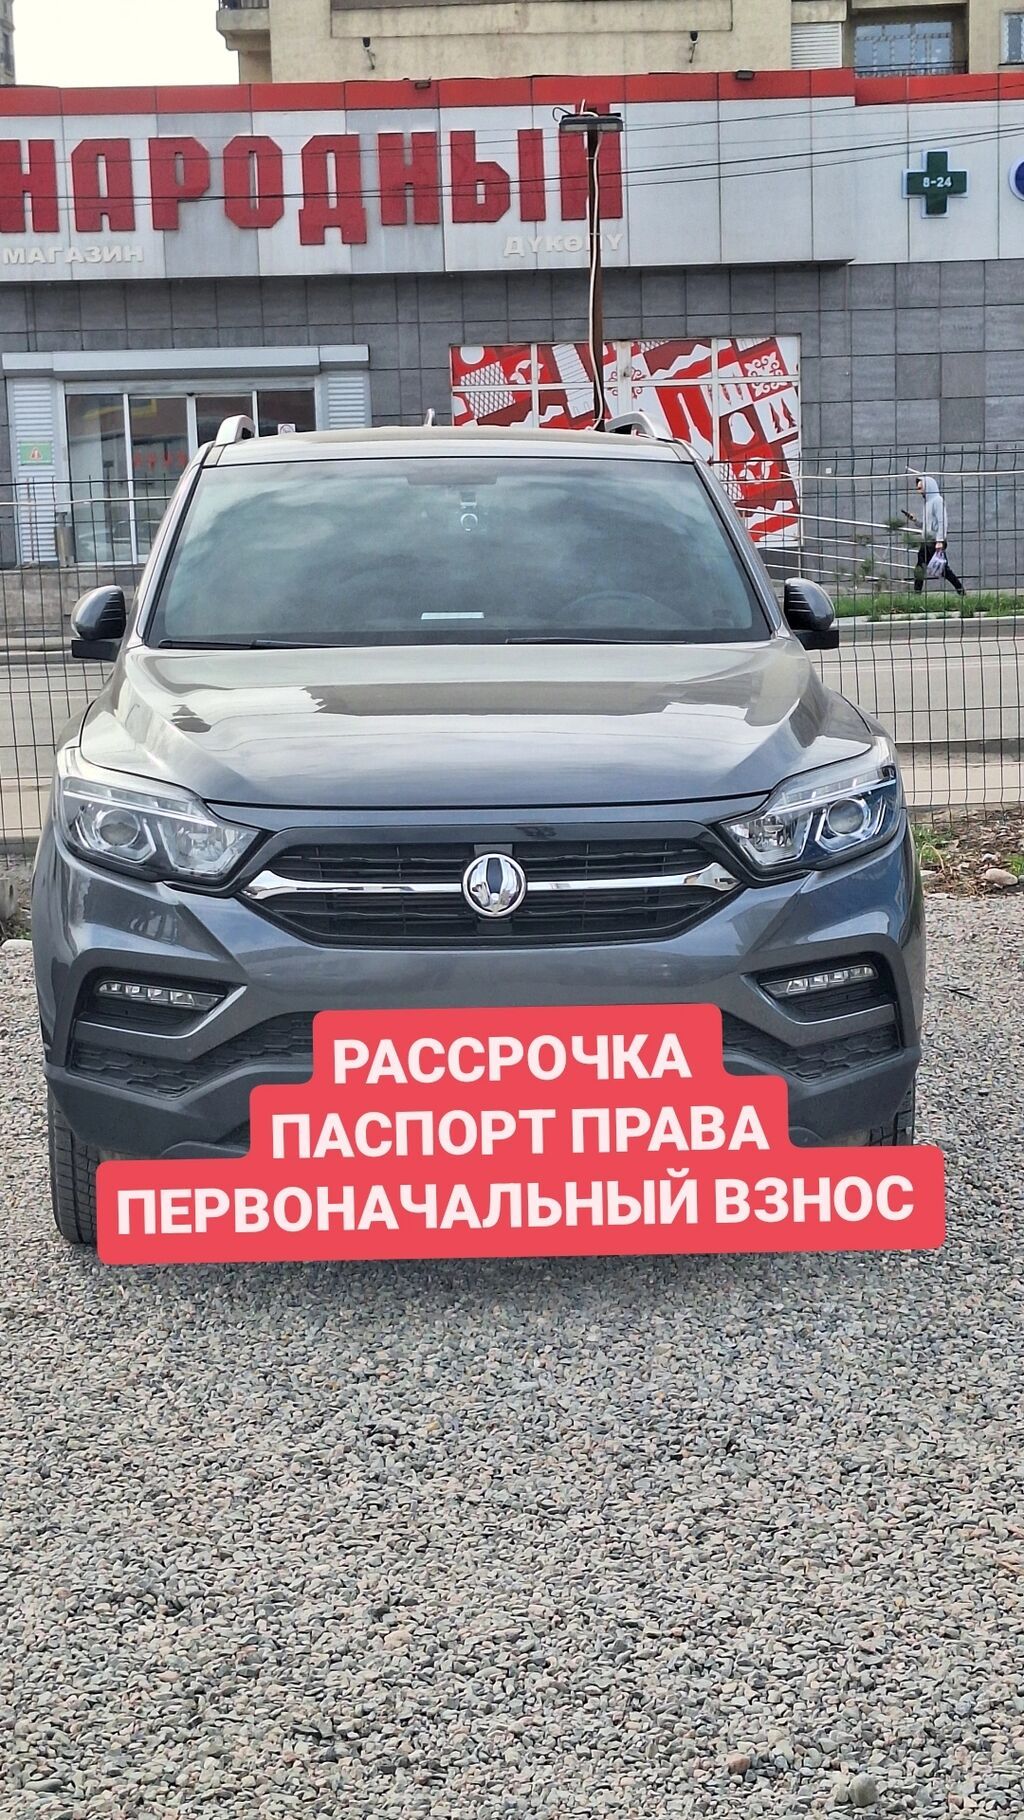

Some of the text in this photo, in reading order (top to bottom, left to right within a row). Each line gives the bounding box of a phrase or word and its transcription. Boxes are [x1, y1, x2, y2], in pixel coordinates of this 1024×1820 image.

[0, 104, 623, 244] НАРОДНЫЙ
[922, 177, 952, 187] 8-24
[2, 246, 144, 264] МАГАЗИН
[503, 233, 623, 258] ДҮКӨҮ
